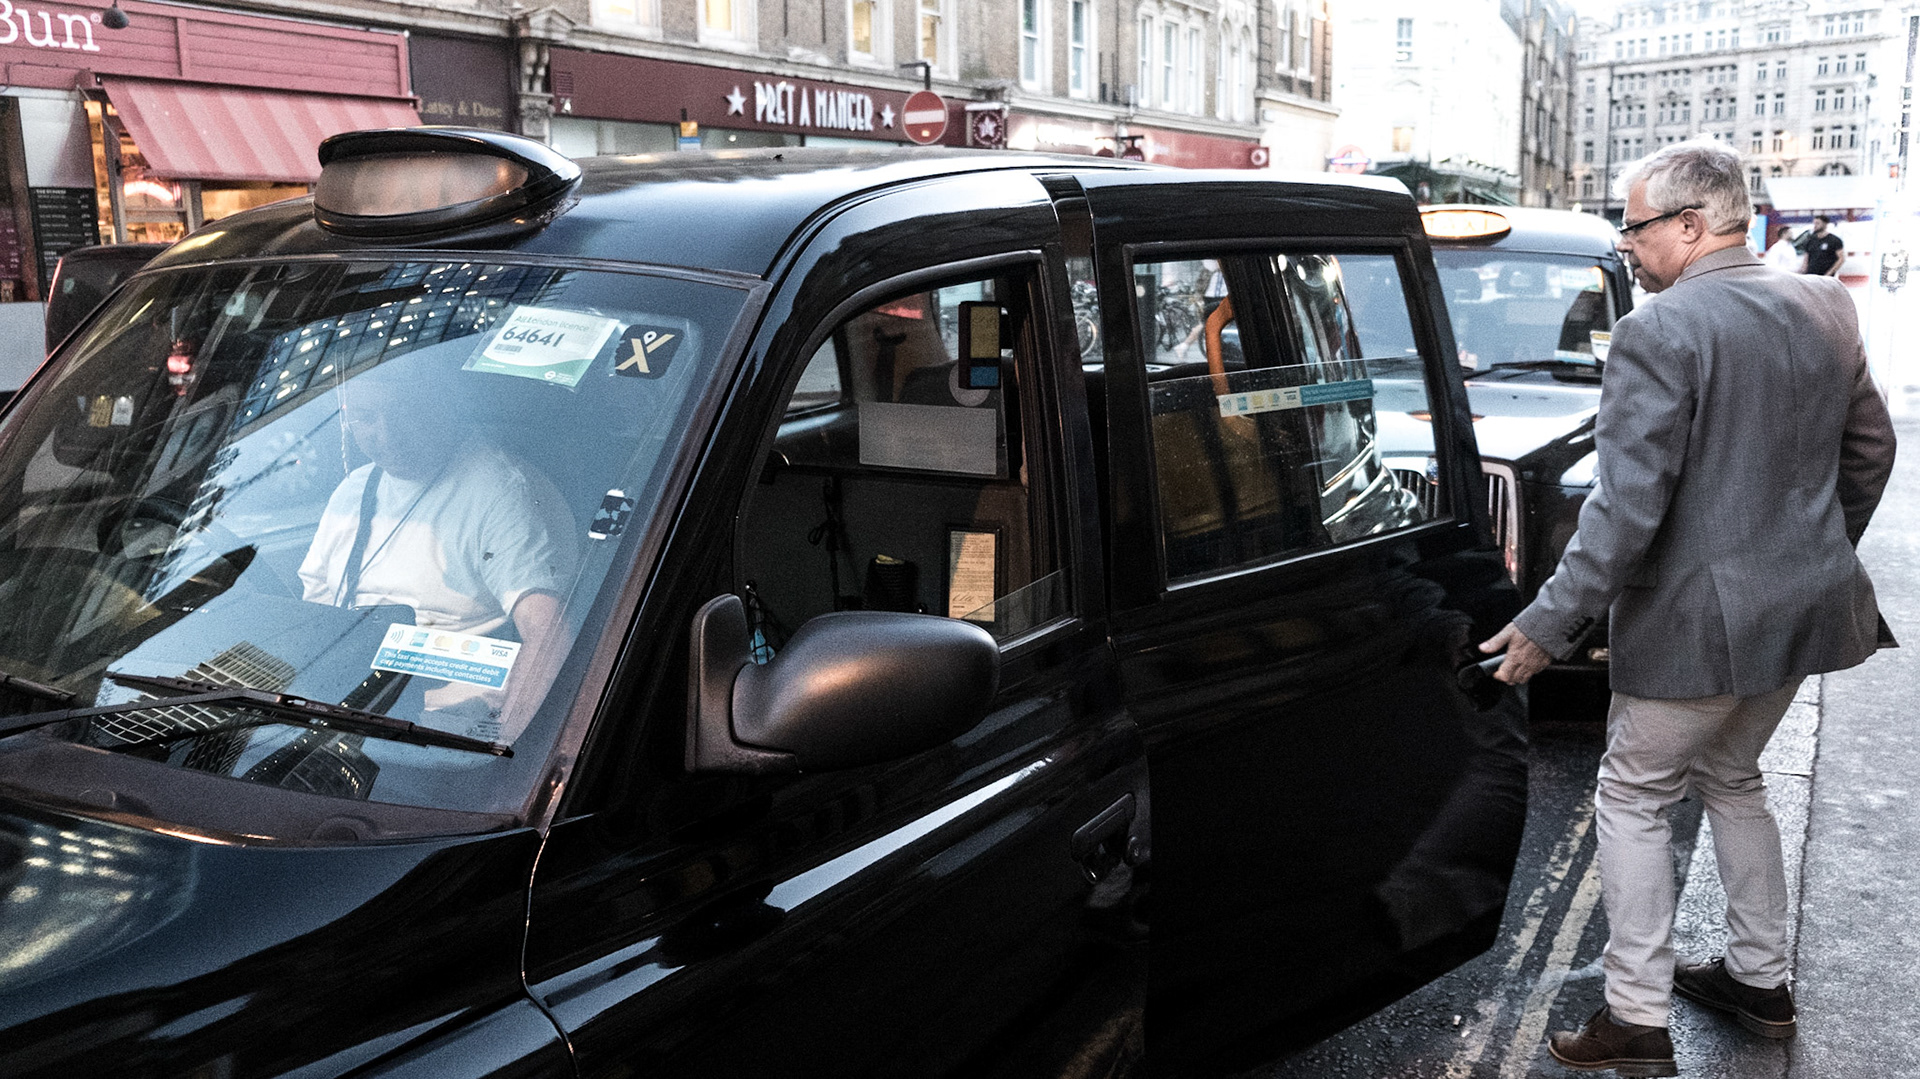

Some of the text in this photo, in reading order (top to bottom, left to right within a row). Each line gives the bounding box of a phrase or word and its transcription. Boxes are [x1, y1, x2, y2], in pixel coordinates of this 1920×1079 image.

[754, 81, 874, 132] PRET A MANGER
[525, 317, 558, 328] London
[560, 319, 590, 332] licence
[502, 326, 565, 348] 64641
[491, 648, 508, 658] VISA
[393, 661, 424, 671] payments
[424, 664, 454, 677] including
[454, 670, 492, 683] contactless
[424, 656, 449, 668] accepts
[449, 662, 469, 671] credit
[468, 665, 482, 674] and
[481, 668, 500, 677] debit
